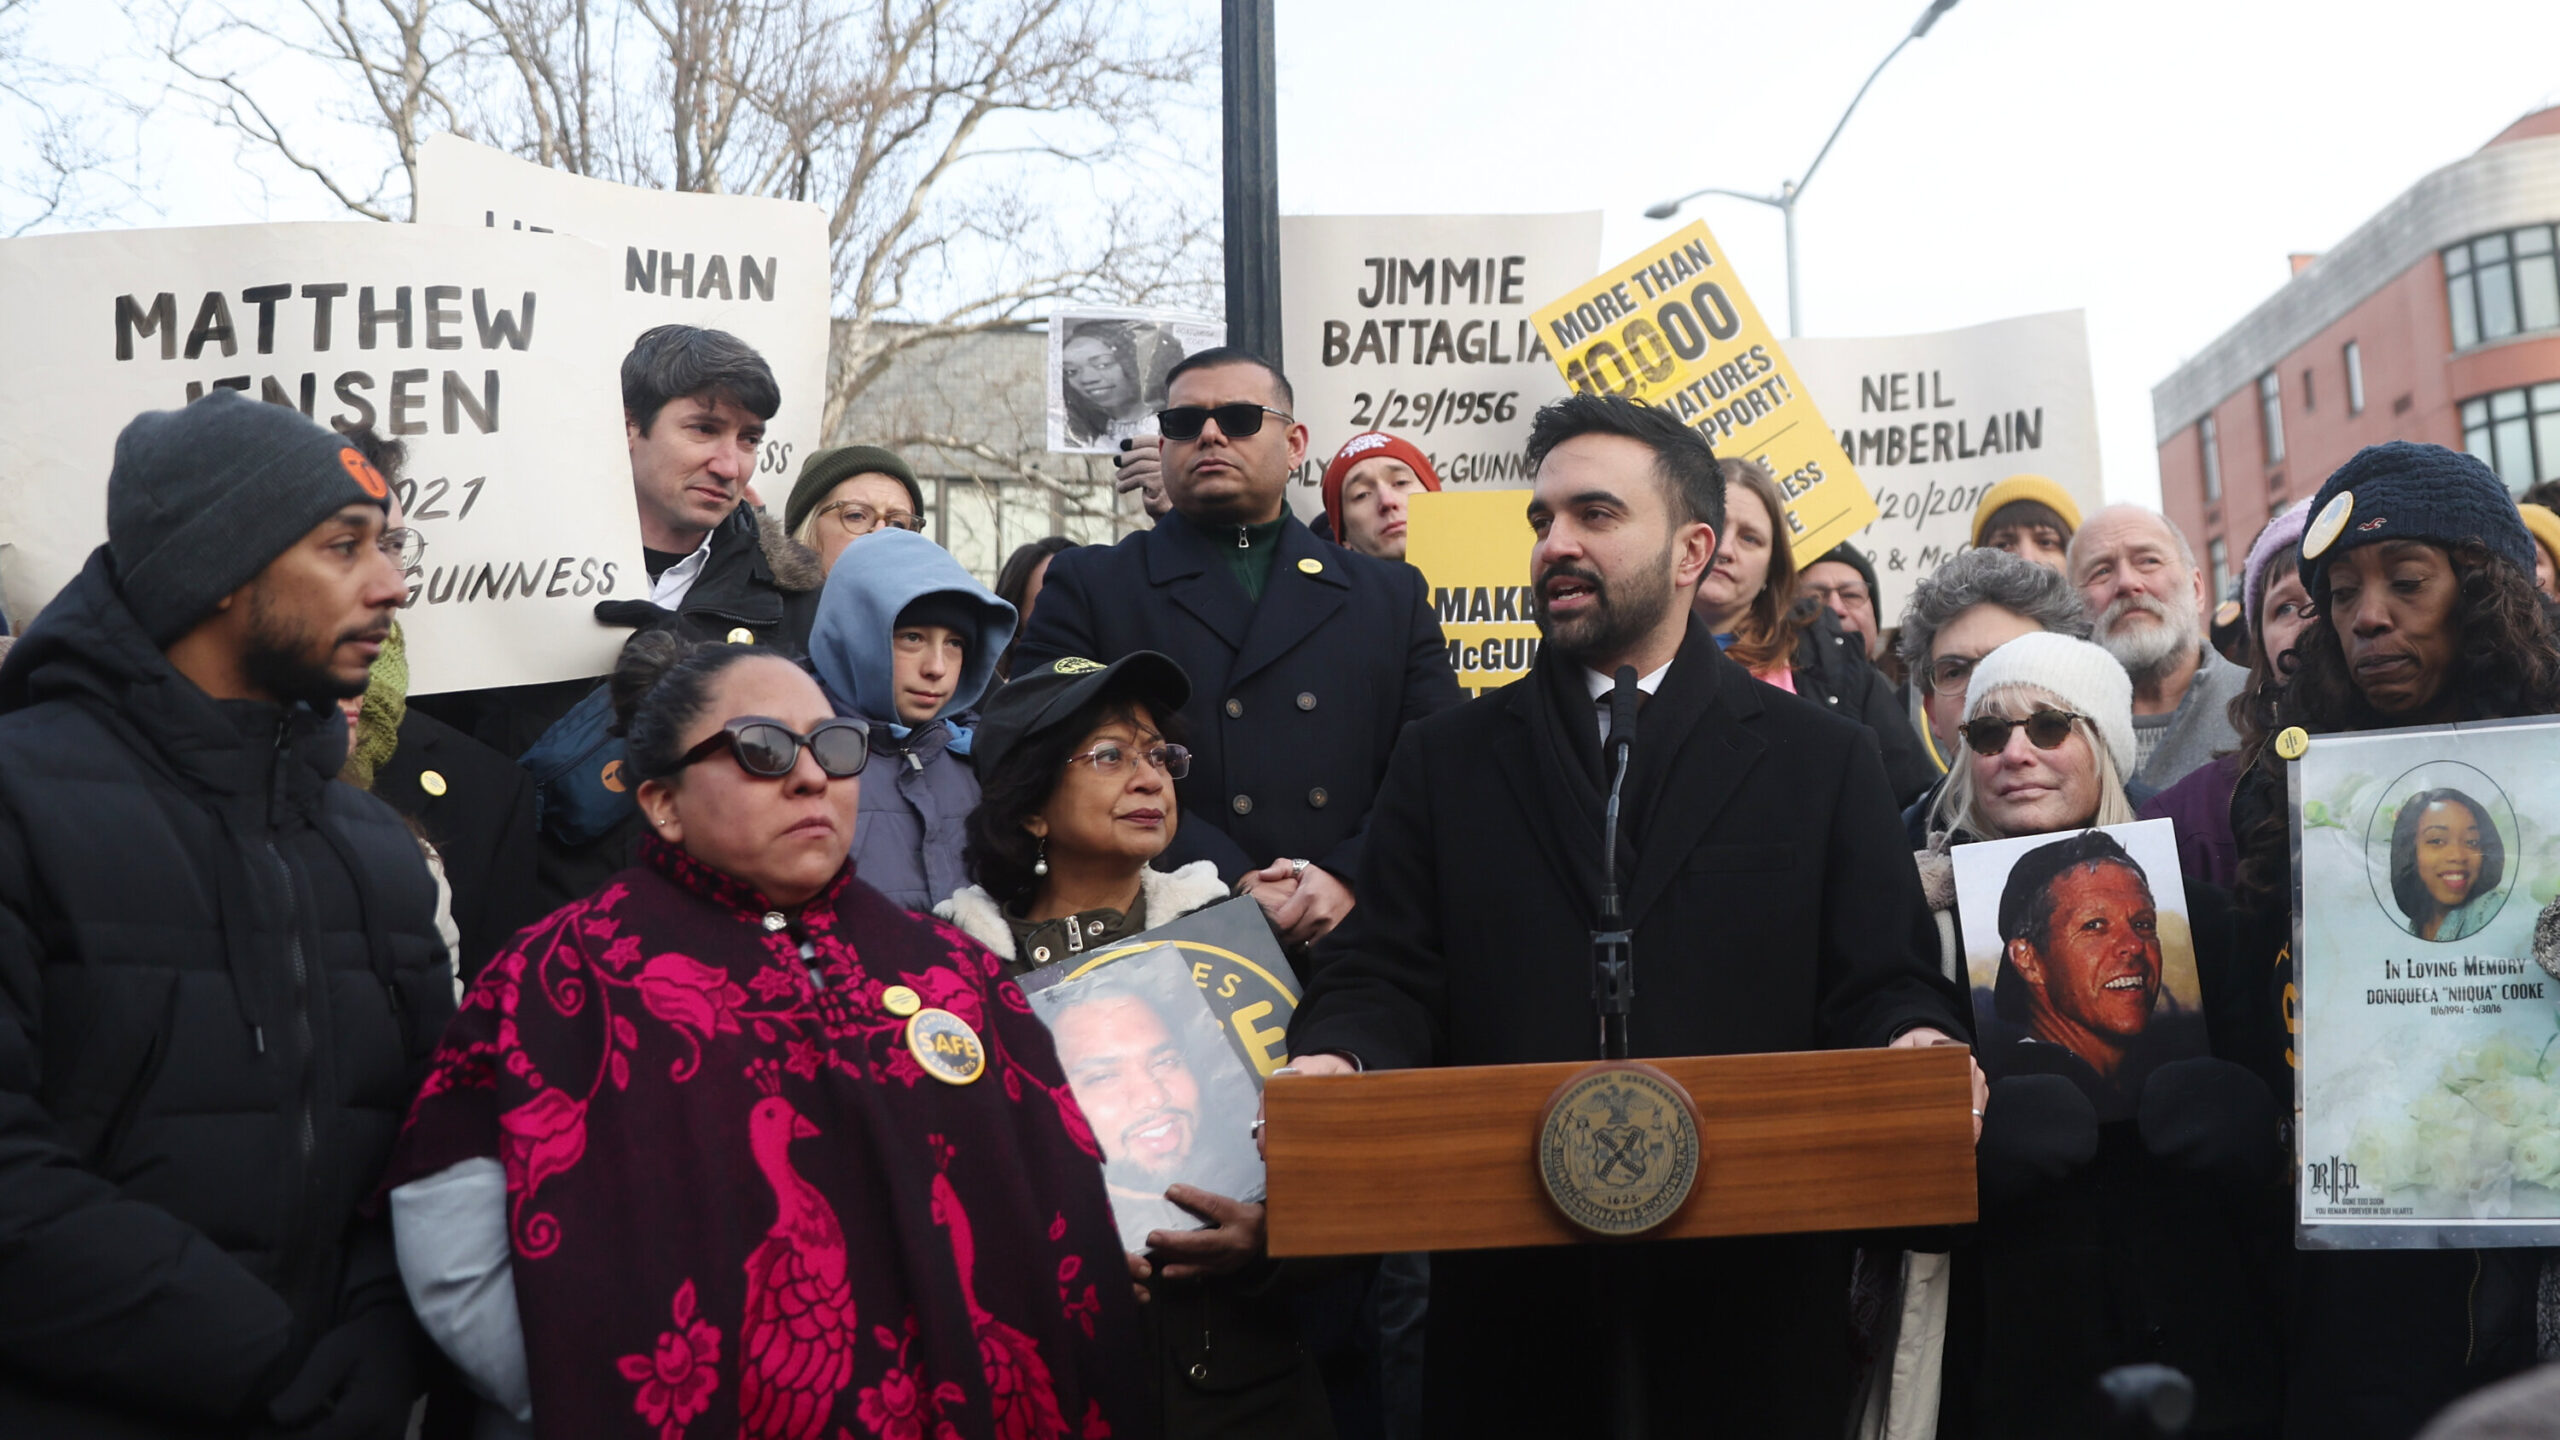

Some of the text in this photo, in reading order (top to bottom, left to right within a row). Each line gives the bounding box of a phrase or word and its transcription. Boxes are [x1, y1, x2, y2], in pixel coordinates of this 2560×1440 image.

[625, 246, 777, 301] NHAN
[1358, 256, 1526, 308] JIMMIE
[1550, 239, 1714, 349] MORE THAN
[115, 283, 537, 360] MATTHEW
[1321, 317, 1552, 367] BATTAGLIA
[186, 368, 500, 434] NSEN
[1350, 391, 1518, 434] 2/29/1956
[1698, 373, 1793, 447] PPORT!
[1861, 370, 1955, 413] NEIL
[756, 440, 793, 474] SS
[1831, 407, 2043, 466] AMBERLAIN
[1427, 451, 1537, 484] cGUINN
[1434, 586, 1534, 622] MAKE
[2367, 987, 2438, 1006] DONIQUECA
[2502, 983, 2545, 1000] COOKE
[918, 1031, 979, 1059] SAFE
